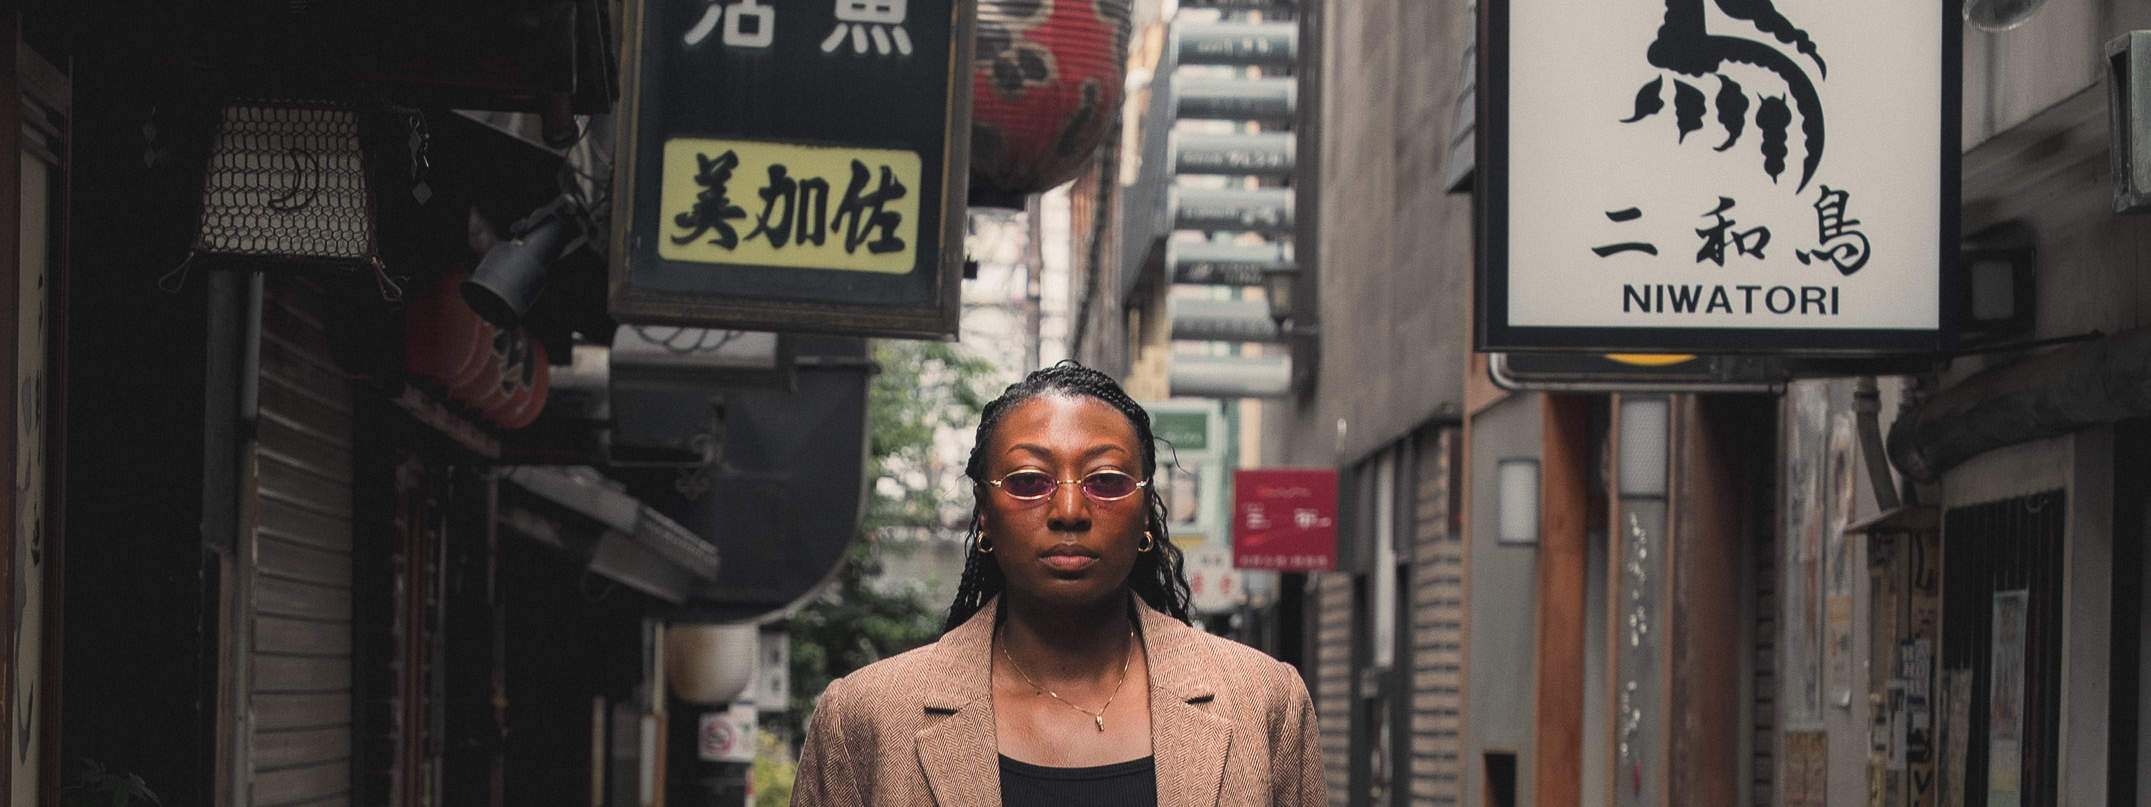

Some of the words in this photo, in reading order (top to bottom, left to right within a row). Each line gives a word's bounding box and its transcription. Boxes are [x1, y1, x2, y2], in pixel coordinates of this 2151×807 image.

[670, 149, 907, 255] 美加佐
[1591, 184, 1871, 276] 二和鳥
[1622, 284, 1840, 315] NIWATORI
